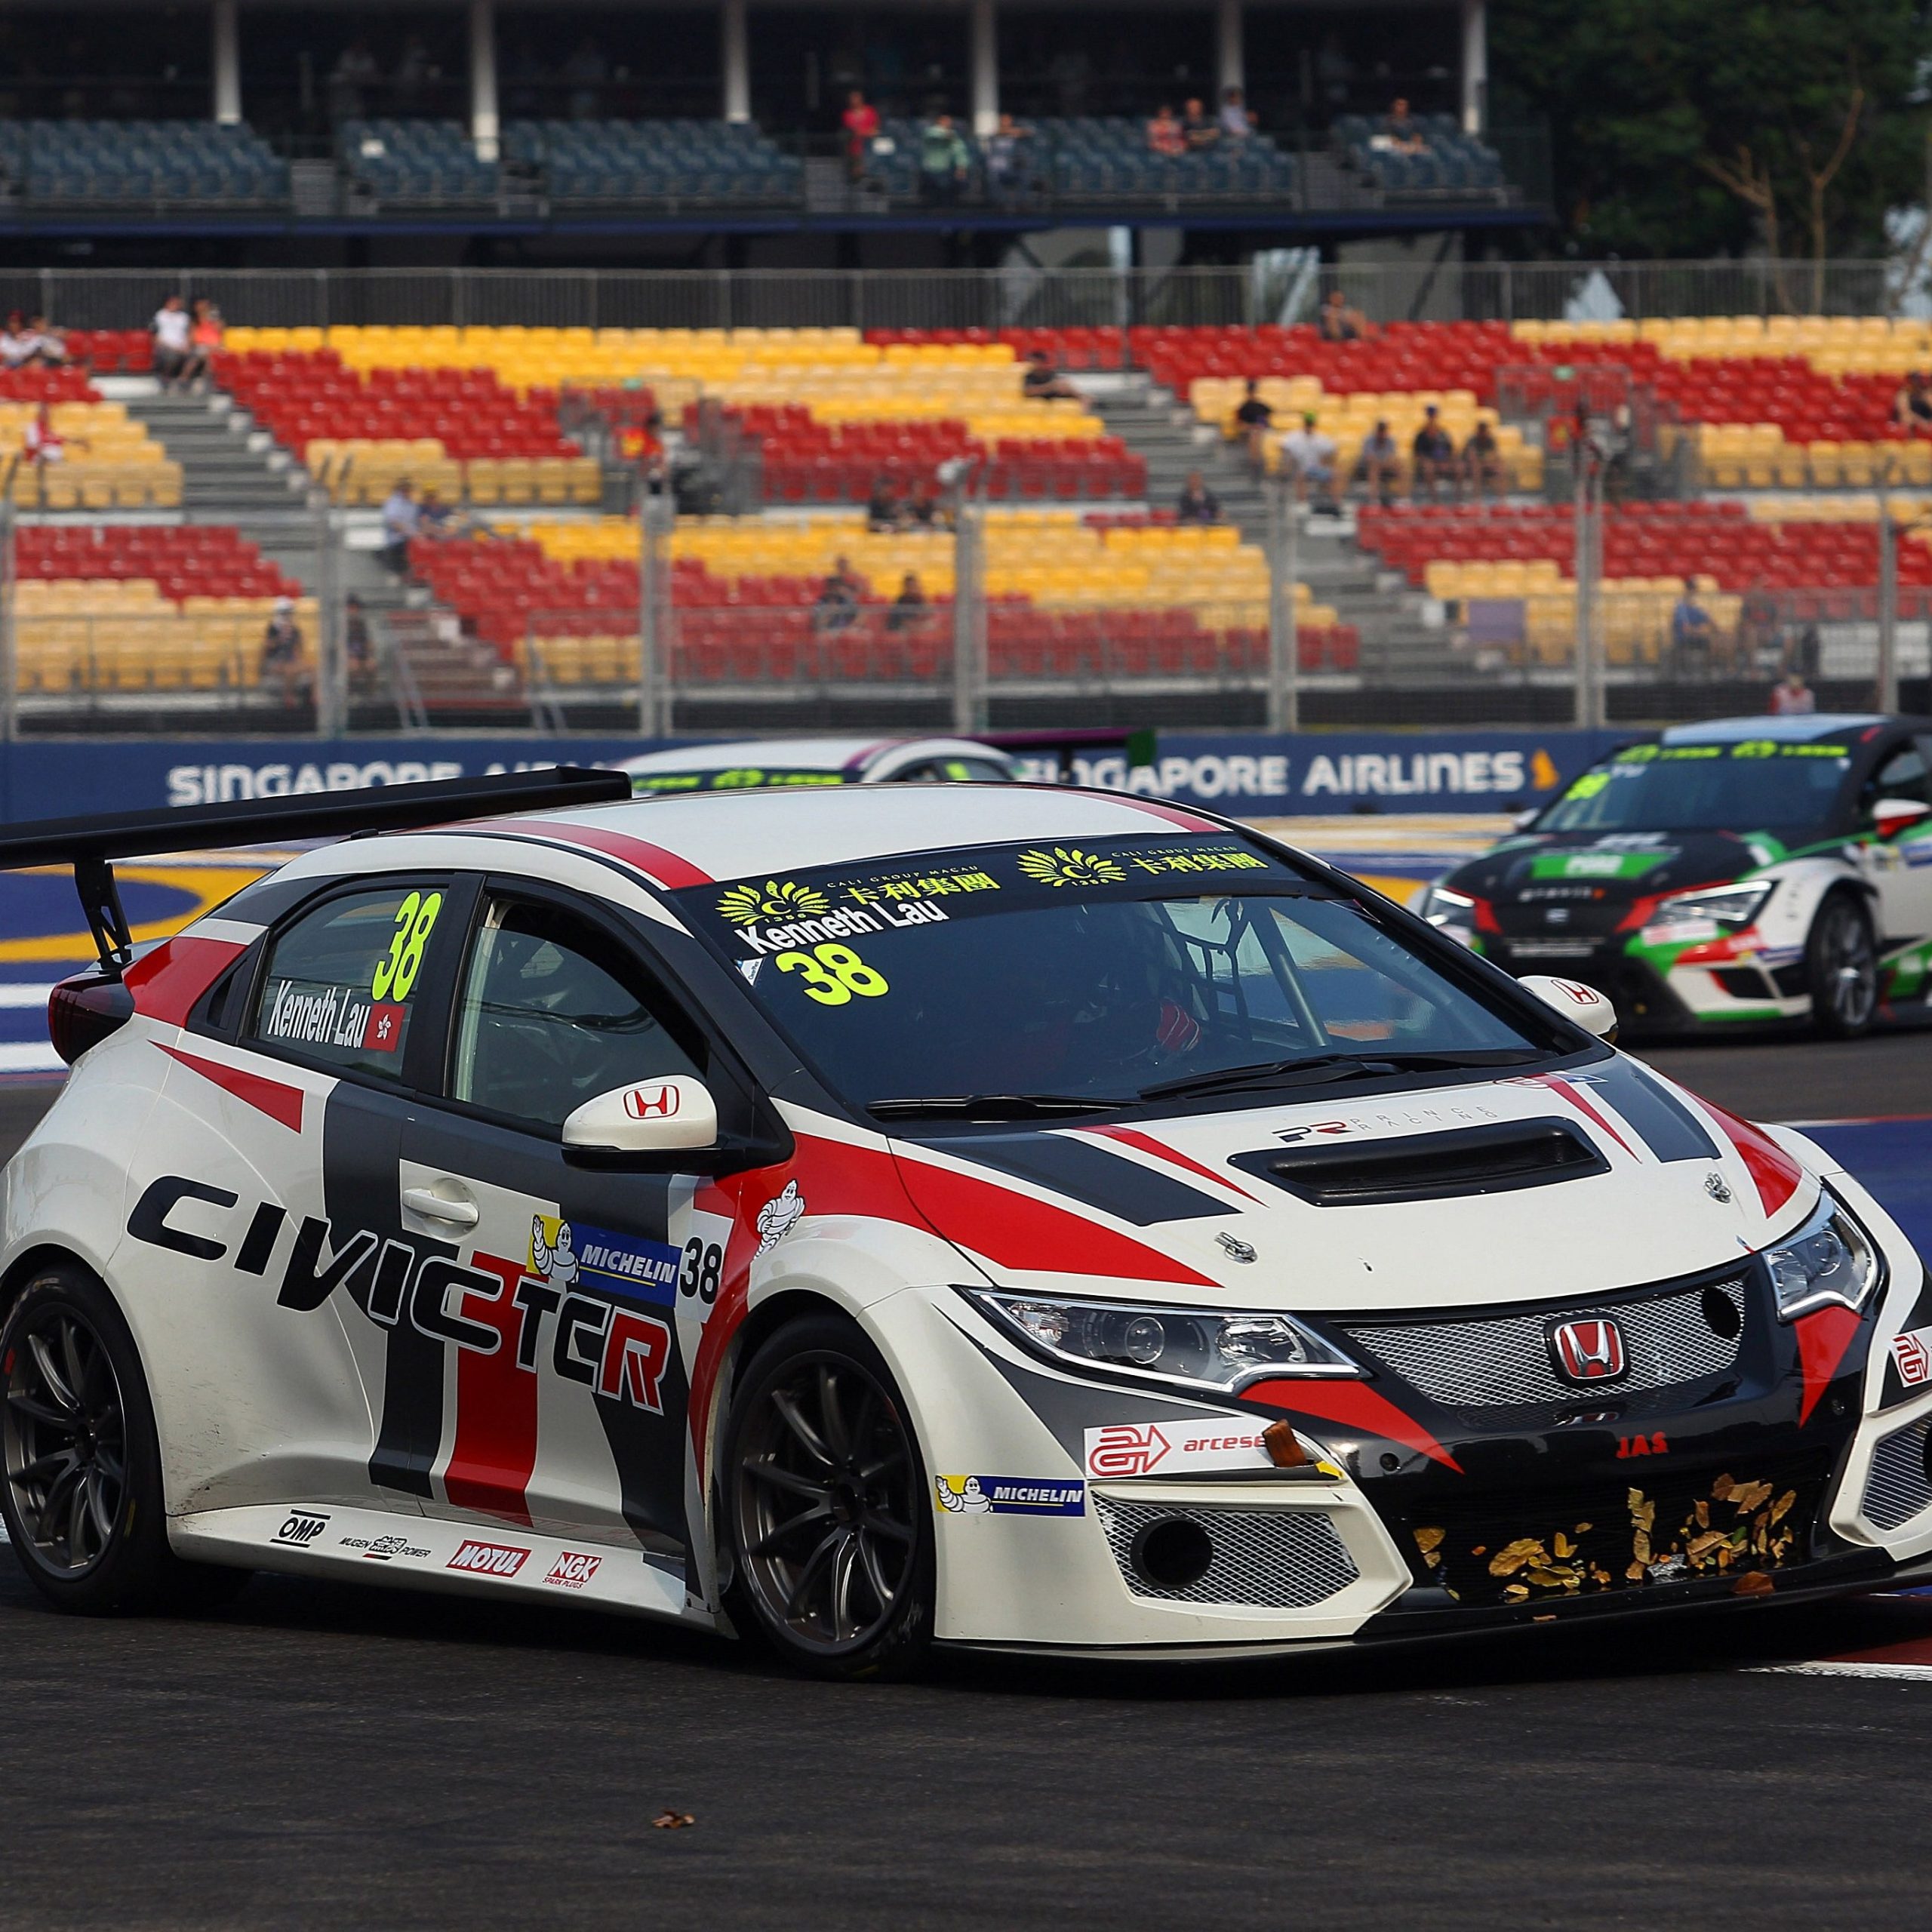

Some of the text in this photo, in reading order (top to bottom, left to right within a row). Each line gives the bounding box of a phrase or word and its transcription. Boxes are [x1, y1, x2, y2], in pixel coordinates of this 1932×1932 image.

[1303, 752, 1524, 797] AIRLINES
[826, 865, 978, 888] CALI GROUP MACAU
[734, 900, 950, 955] Kenneth Lau
[372, 891, 441, 1001] 38
[775, 943, 889, 1006] 38
[267, 980, 371, 1048] Kenneth Lau
[580, 1244, 677, 1284] MICHELIN
[680, 1236, 723, 1305] 38
[127, 1175, 671, 1416] CIVIC TCR
[1183, 1435, 1266, 1452] arcese
[1616, 1431, 1669, 1459] JAS
[993, 1486, 1083, 1503] MICHELIN
[278, 1517, 326, 1542] OMP
[338, 1537, 373, 1549] MUGEN
[398, 1546, 432, 1558] POWER
[451, 1545, 524, 1574] MOTUL
[543, 1576, 584, 1589] SPARK PLUGS
[549, 1553, 601, 1583] NGK
